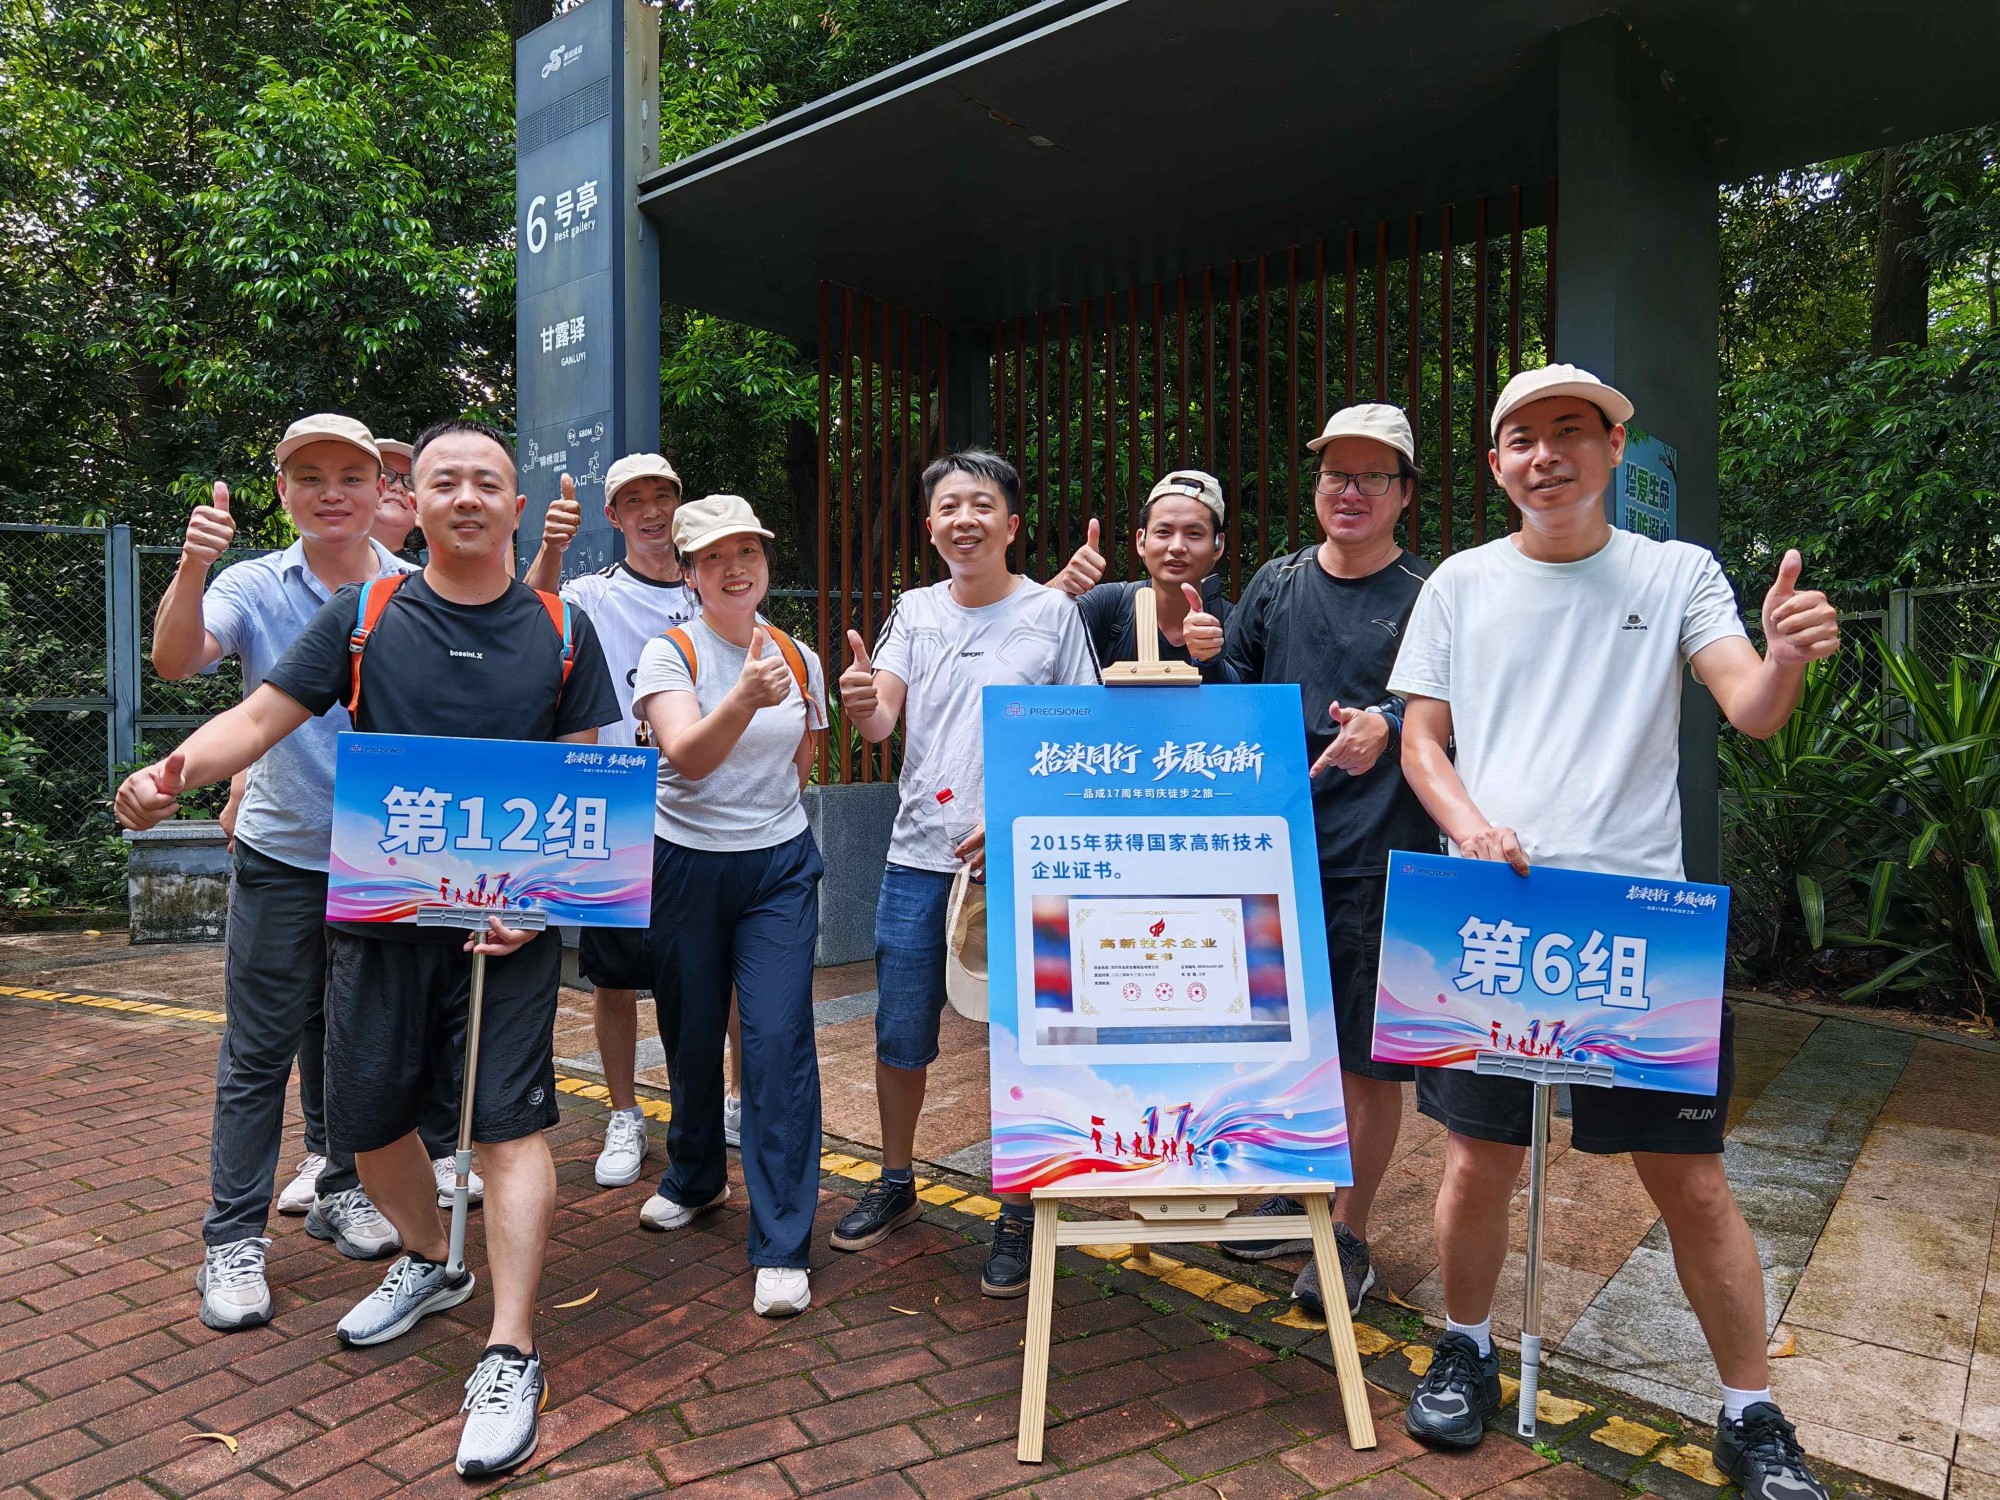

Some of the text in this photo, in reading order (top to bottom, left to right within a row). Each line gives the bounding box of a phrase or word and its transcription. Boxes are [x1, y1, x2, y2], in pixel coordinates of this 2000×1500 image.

[526, 179, 598, 254] 6 号亭
[554, 217, 596, 243] Rest gallery
[540, 315, 586, 353] 甘露驿
[560, 351, 586, 367] GANLUYI
[1624, 460, 1671, 514] 珍爱生命
[1029, 707, 1092, 716] PRECISIONER
[1029, 739, 1267, 785] 拾柒同行 步履向新
[1083, 788, 1214, 799] 品成17周年司庆徒步之旅
[378, 785, 611, 860] 第12组
[1030, 832, 1274, 852] 2015年获得国家高新技术
[1031, 860, 1122, 880] 企业证书。
[1099, 938, 1218, 949] 高新技术企业
[1452, 915, 1650, 1011] 第6组
[1676, 1108, 1717, 1120] RUN
